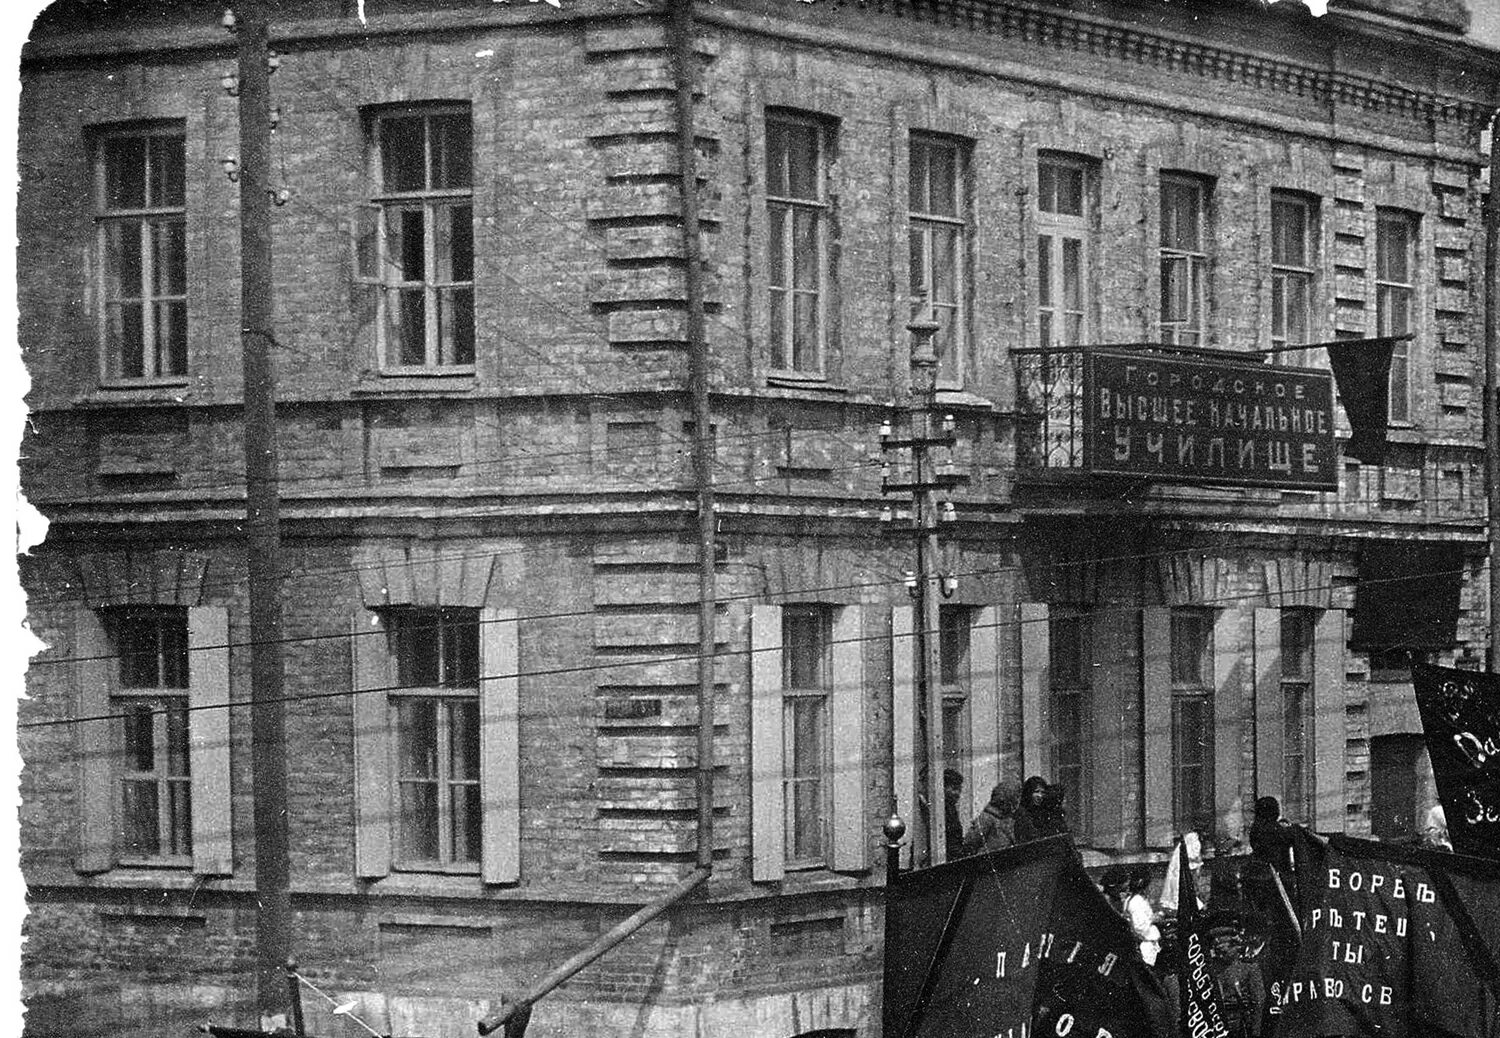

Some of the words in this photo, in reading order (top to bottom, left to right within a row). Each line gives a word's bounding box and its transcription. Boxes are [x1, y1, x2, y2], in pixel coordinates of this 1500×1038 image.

[1126, 365, 1304, 399] ГОРОДСКОЕ
[1101, 387, 1197, 425] ВЫСШЕЕ
[1209, 404, 1328, 435] НАЧАЛЬНОЕ
[1114, 425, 1320, 475] УЧИЛИЩЕ
[1332, 941, 1363, 964] ТЫ
